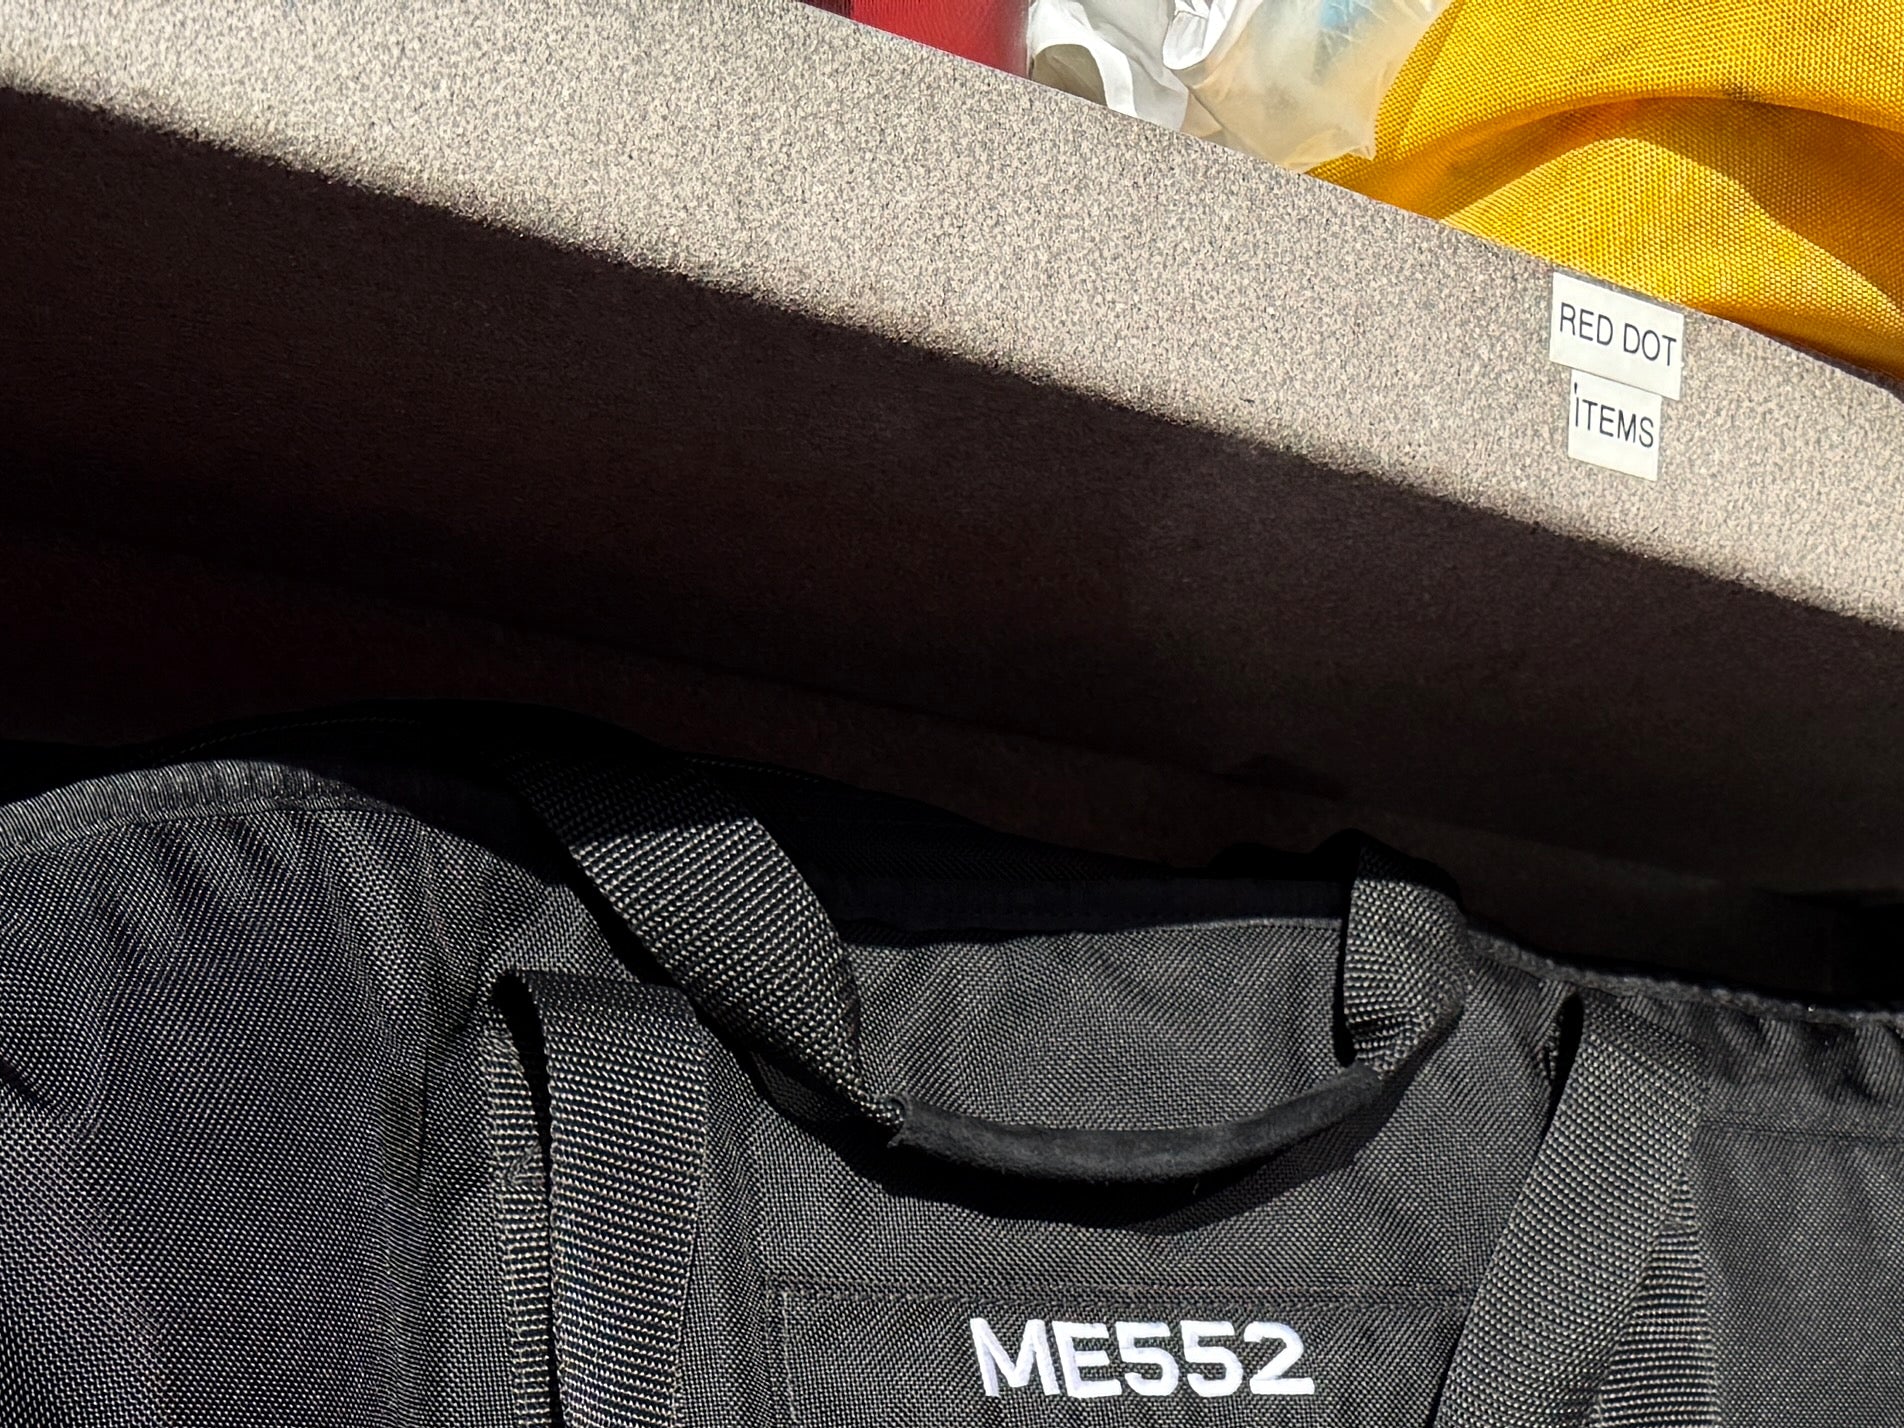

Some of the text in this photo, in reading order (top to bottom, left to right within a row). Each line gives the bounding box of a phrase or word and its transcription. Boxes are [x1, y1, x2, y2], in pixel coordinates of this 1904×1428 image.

[1559, 302, 1677, 366] RED DOT
[969, 1316, 1315, 1399] ME552
